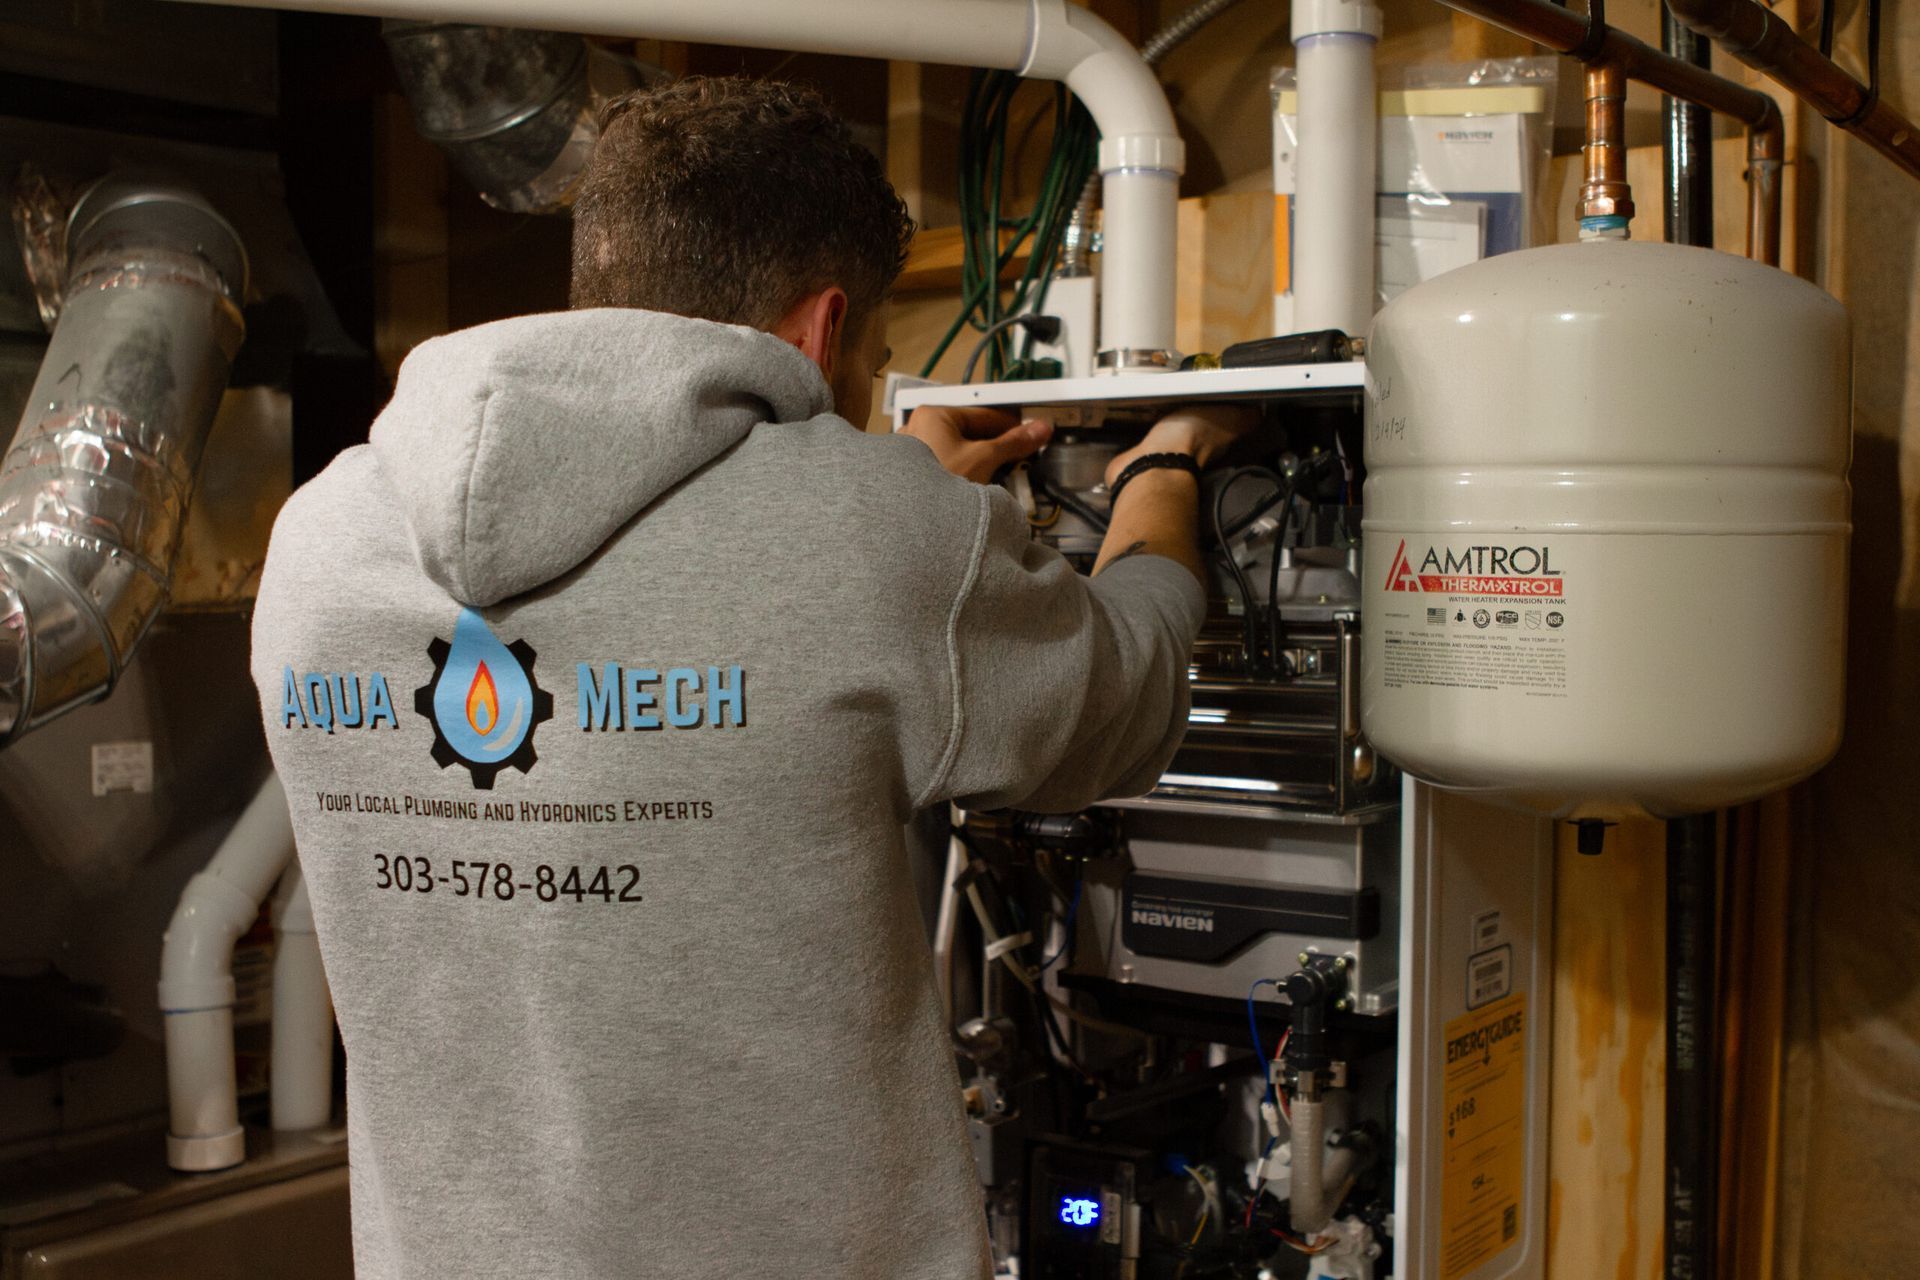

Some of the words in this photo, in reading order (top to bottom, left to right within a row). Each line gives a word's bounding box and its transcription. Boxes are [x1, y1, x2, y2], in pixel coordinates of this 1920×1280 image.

[1419, 546, 1560, 575] AMTROL
[1448, 596, 1470, 604] WATER
[1471, 596, 1498, 604] HEATER
[1500, 597, 1543, 605] EXPANSION
[282, 662, 399, 735] AQUA
[576, 661, 747, 732] MECH
[317, 792, 352, 812] YOUR
[356, 793, 400, 814] LOCAL
[405, 795, 477, 819] PLUMBING
[484, 803, 514, 821] AND
[520, 801, 616, 822] HYDRONICS
[624, 801, 713, 821] EXPERTS
[374, 853, 643, 903] 303-578-8442
